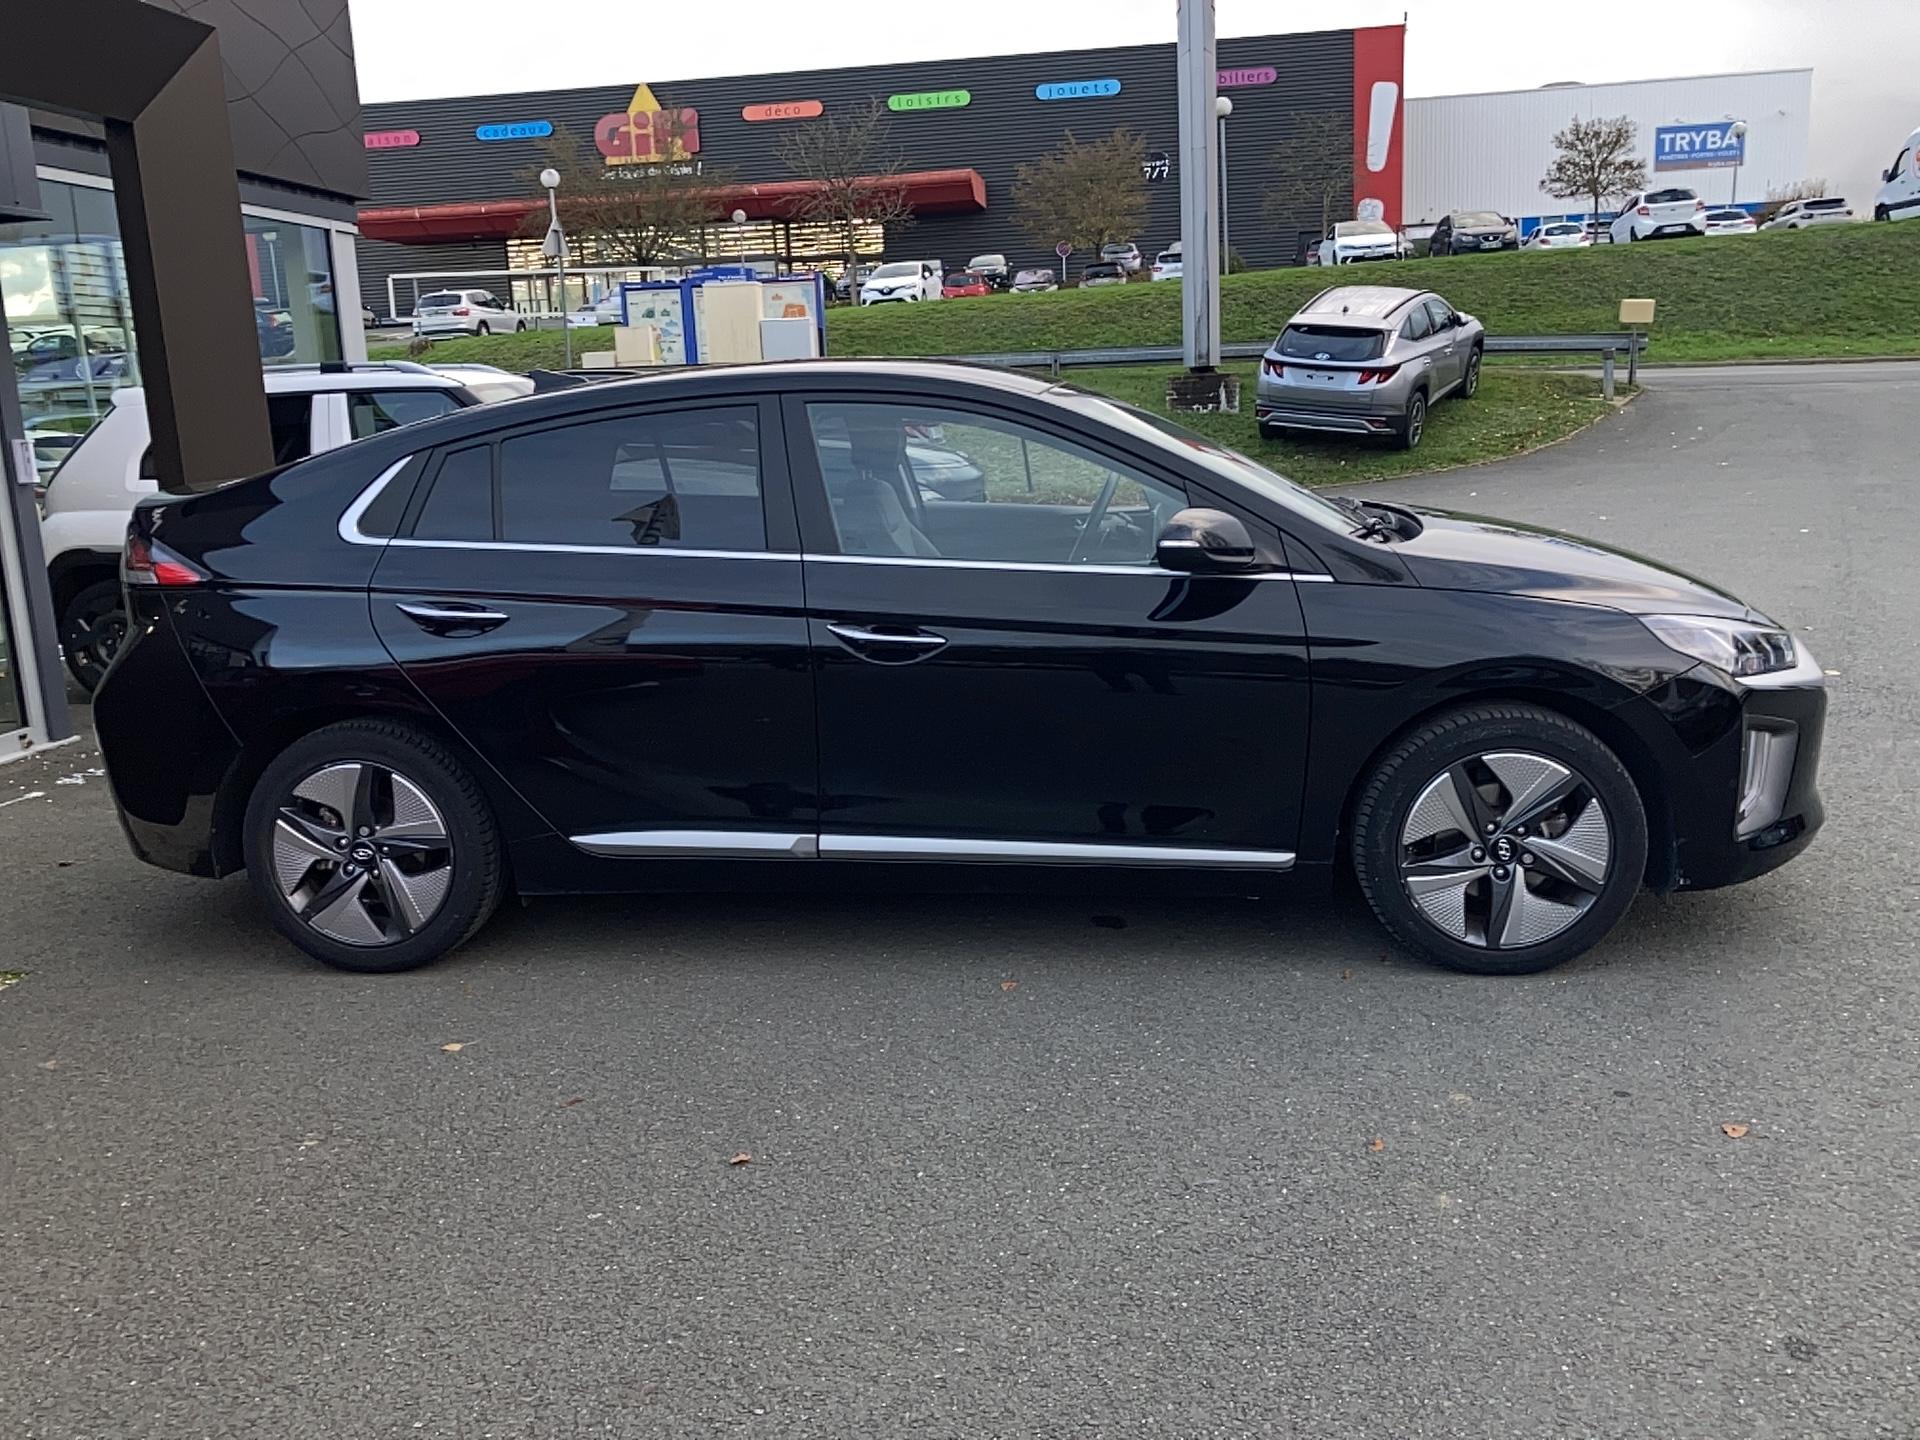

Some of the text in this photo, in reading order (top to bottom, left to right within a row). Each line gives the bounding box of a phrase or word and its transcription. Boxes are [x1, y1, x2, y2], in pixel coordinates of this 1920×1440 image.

[1218, 71, 1270, 84] biliers
[1046, 83, 1109, 99] jouets
[764, 100, 801, 116] déco
[897, 93, 962, 108] loisirs
[483, 123, 546, 138] cadeaux
[367, 134, 412, 146] aison
[1660, 130, 1739, 152] TRYBA
[1143, 166, 1169, 179] 7/7
